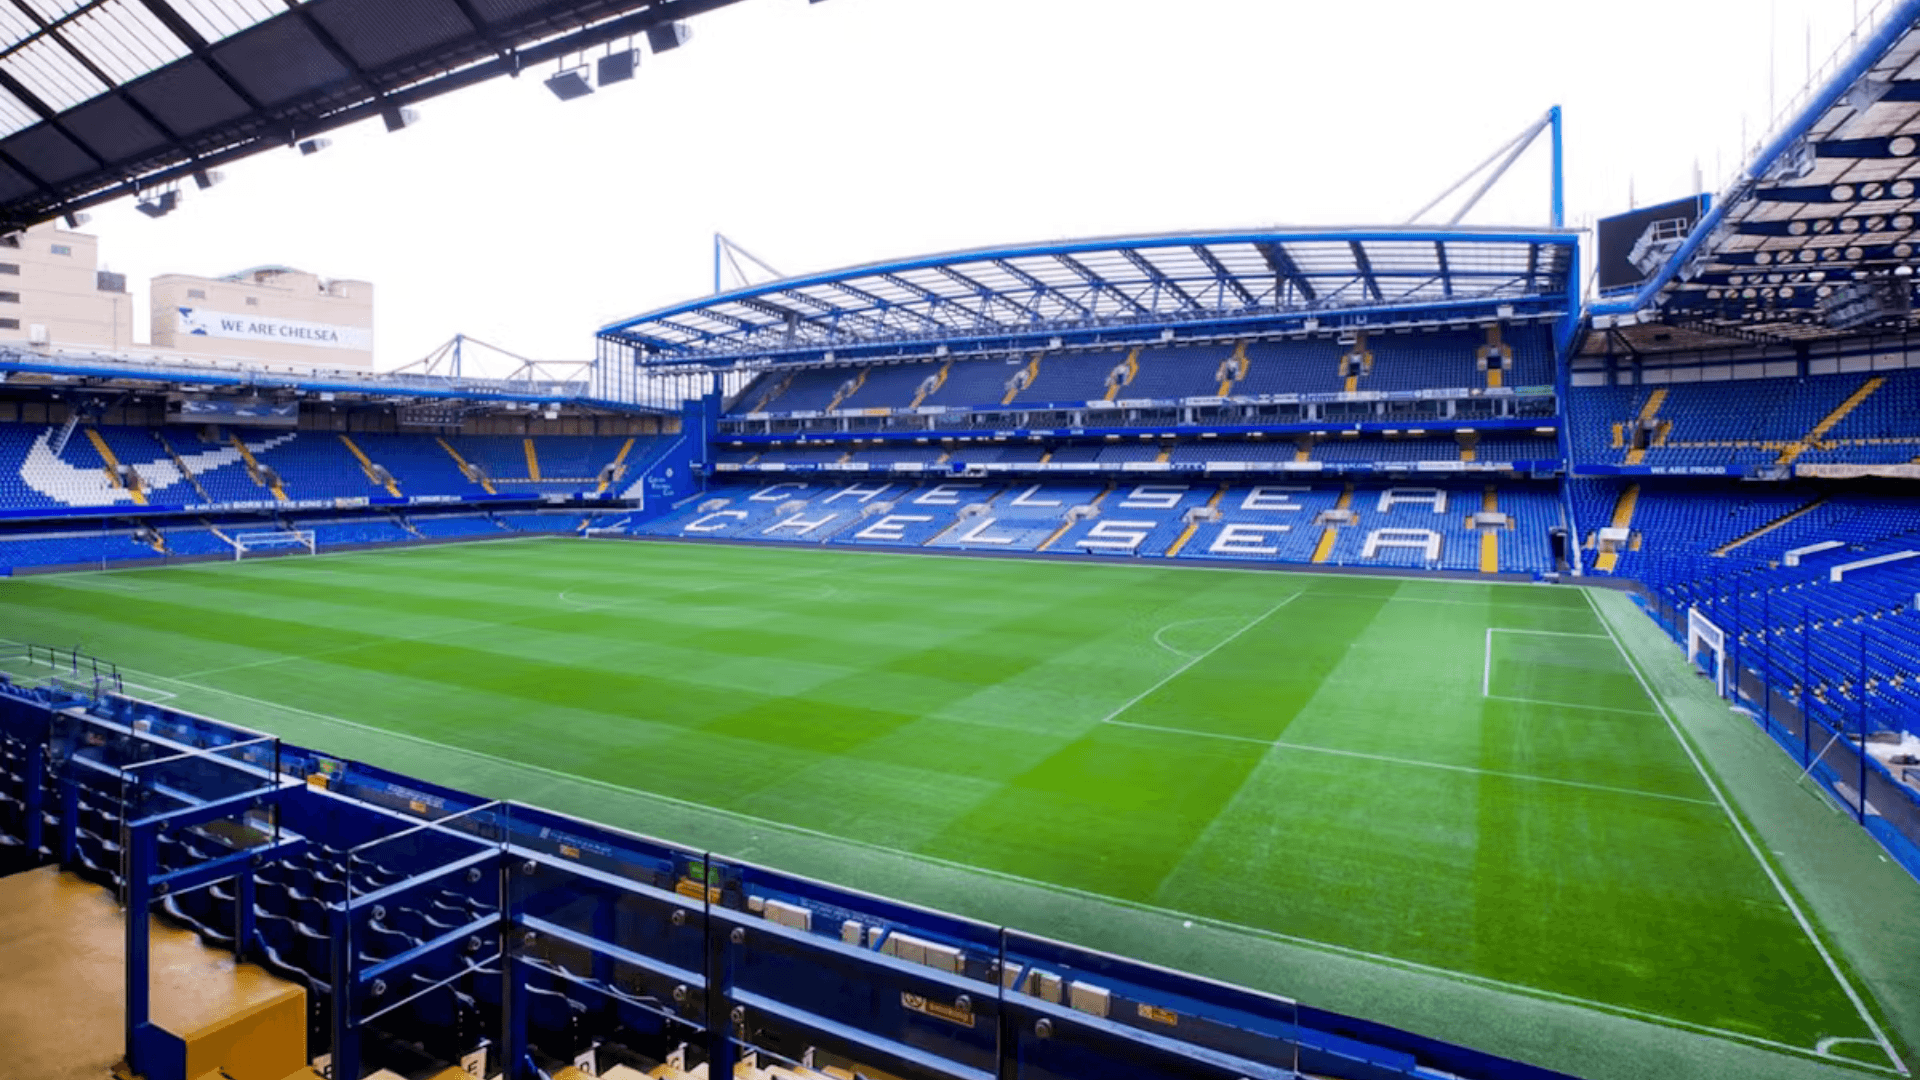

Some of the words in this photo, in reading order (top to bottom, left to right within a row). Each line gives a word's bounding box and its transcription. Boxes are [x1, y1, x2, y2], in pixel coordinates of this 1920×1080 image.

[221, 319, 244, 332] WE
[248, 322, 276, 336] ARE
[279, 325, 339, 342] CHELSEA
[1651, 466, 1665, 475] WE
[1668, 466, 1687, 475] ARE
[1689, 466, 1726, 475] PROUD
[748, 483, 1448, 513] CHELSEA
[684, 509, 1443, 561] CHELSEA
